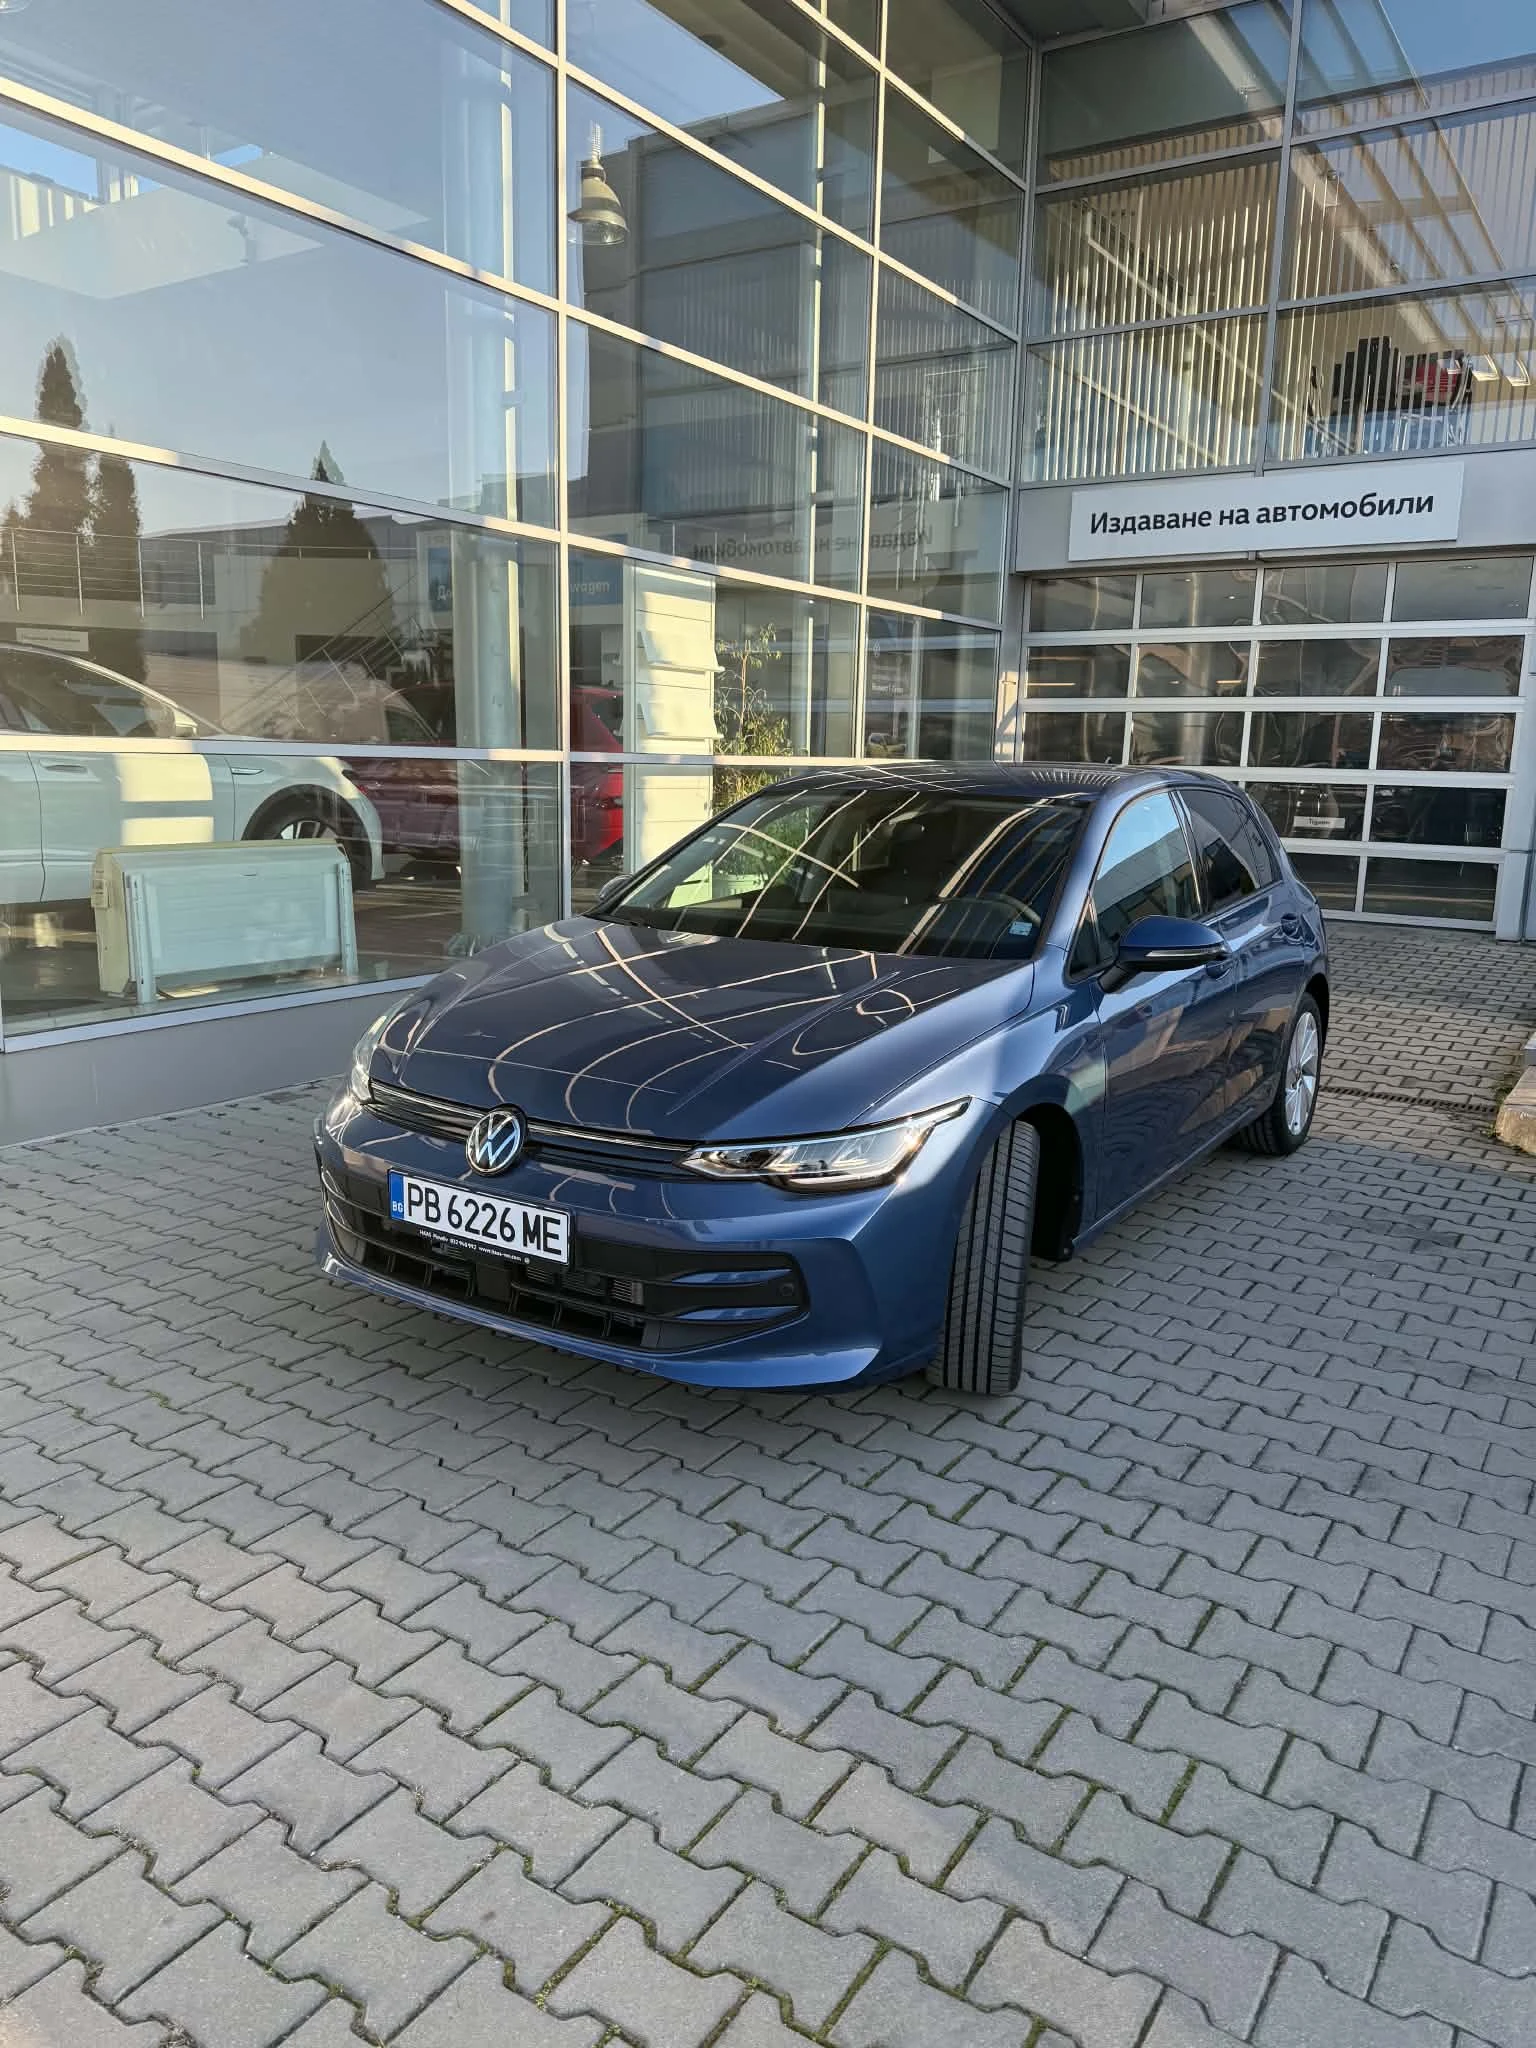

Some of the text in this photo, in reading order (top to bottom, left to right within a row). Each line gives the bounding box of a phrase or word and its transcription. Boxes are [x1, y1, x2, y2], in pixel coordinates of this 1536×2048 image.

[1090, 491, 1434, 535] Издаване на автомобили
[392, 1200, 404, 1213] BG
[407, 1182, 562, 1256] PB 6226 ME
